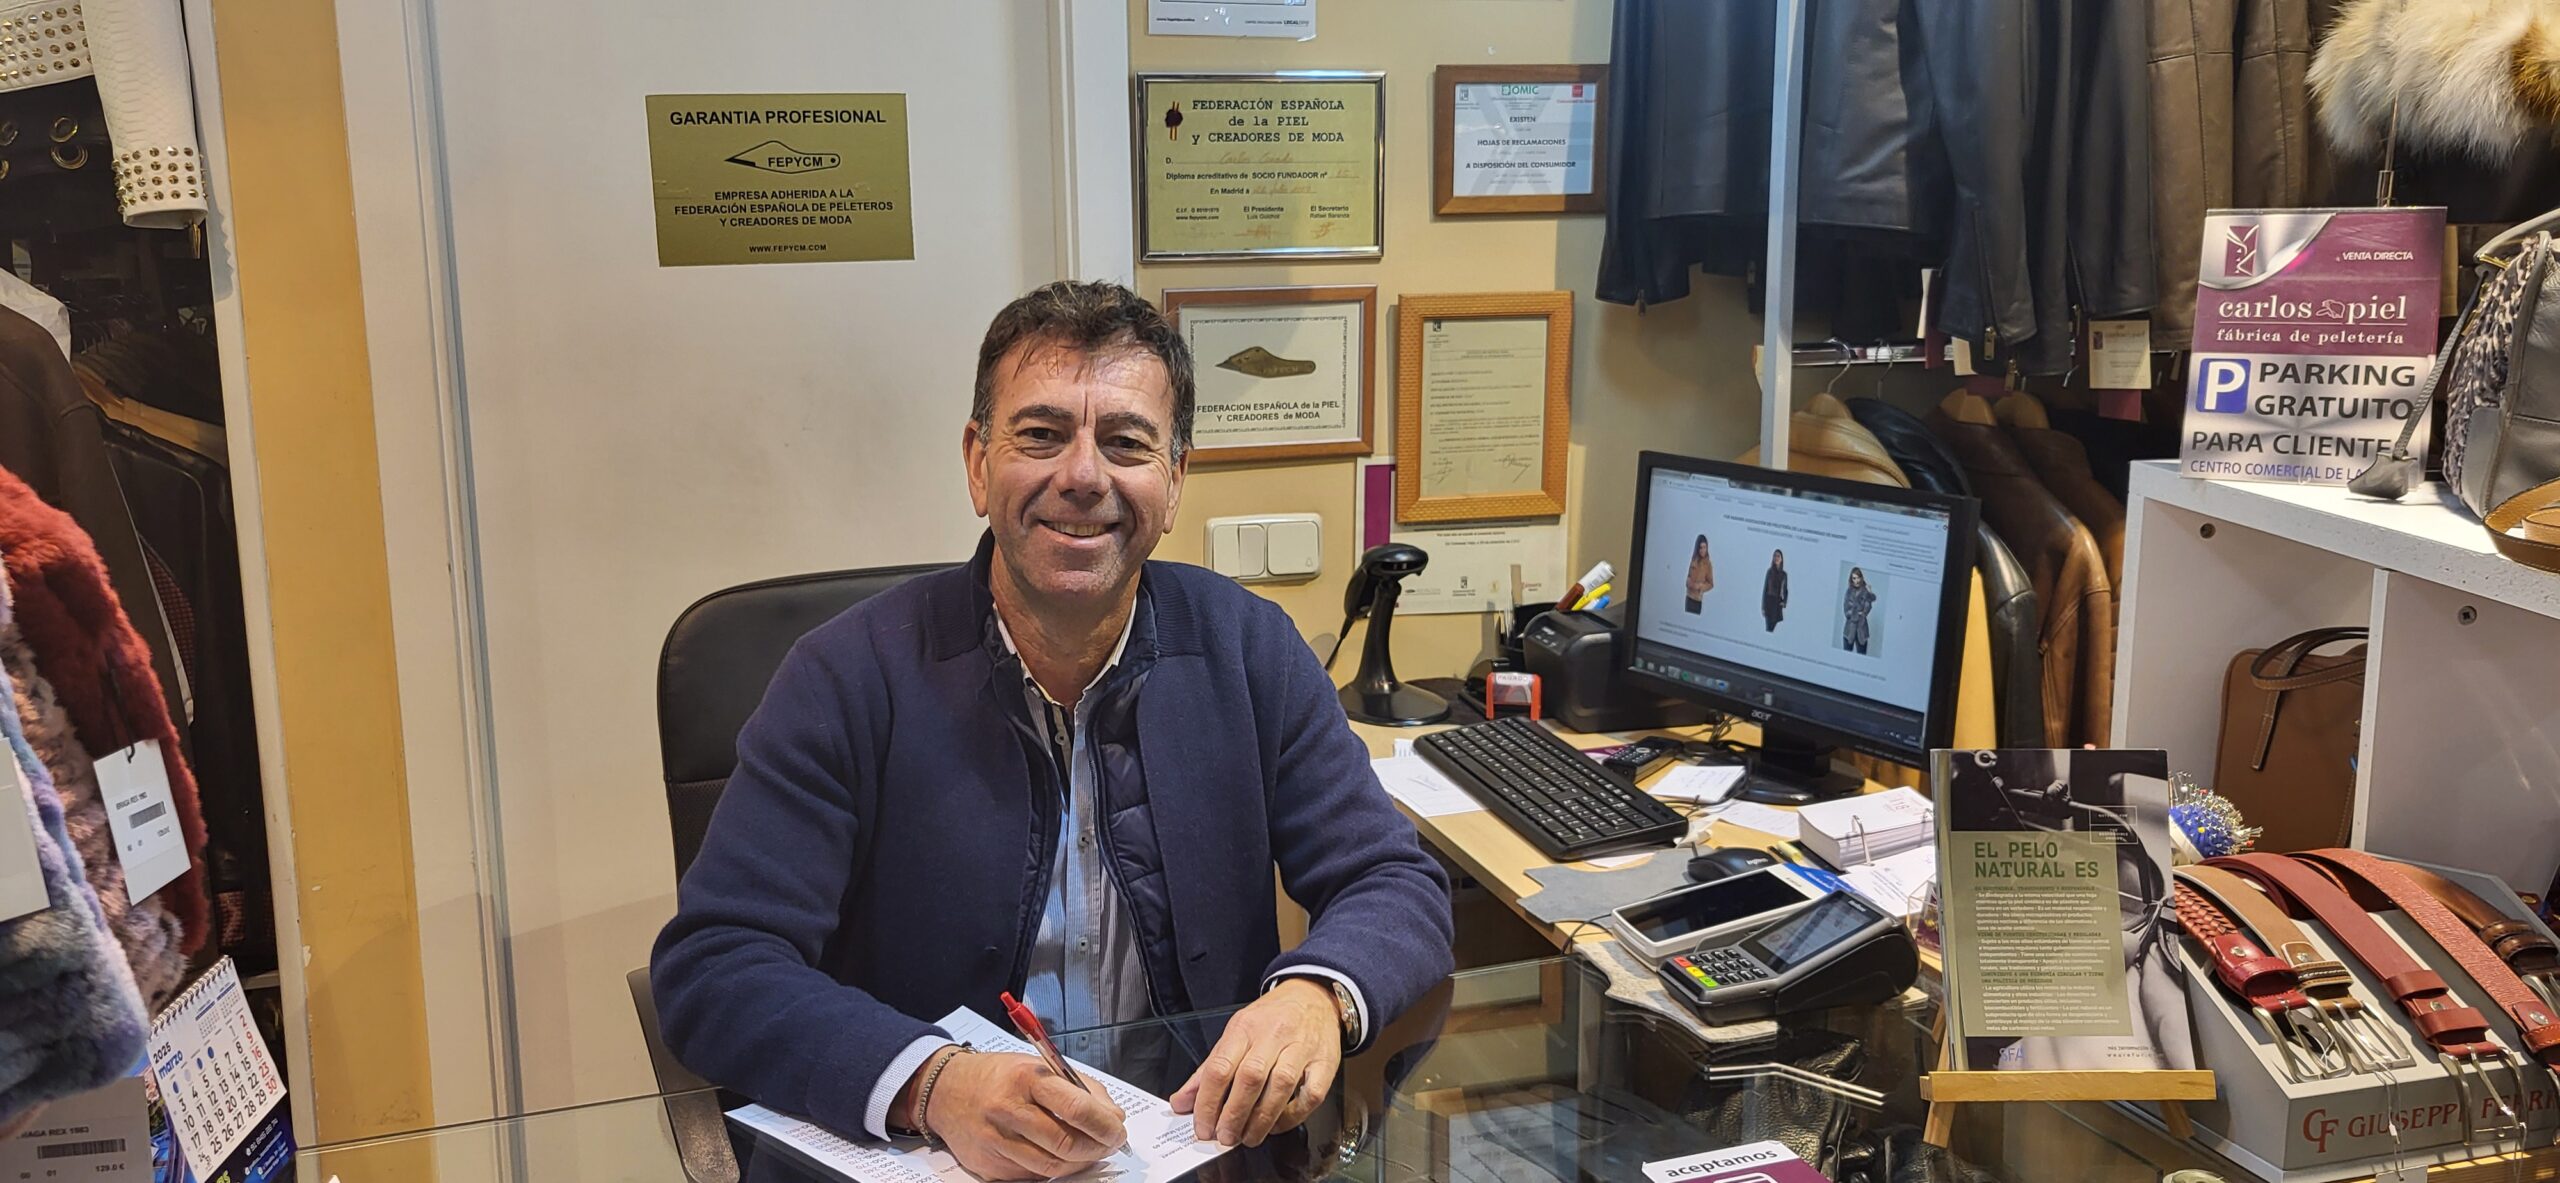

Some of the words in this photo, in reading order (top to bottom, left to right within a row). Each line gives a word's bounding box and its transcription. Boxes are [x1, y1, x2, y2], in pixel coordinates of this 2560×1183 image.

[1512, 86, 1538, 95] OMIC
[1192, 98, 1273, 110] FEDERACIÓN
[1281, 98, 1344, 110] ESPAÑOLA
[670, 111, 761, 125] GARANTIA
[766, 110, 886, 124] PROFESIONAL
[1229, 117, 1245, 126] de
[1253, 117, 1269, 126] la
[1277, 117, 1309, 126] PIEL
[1192, 135, 1199, 145] y
[1208, 132, 1280, 143] CREADORES
[1288, 133, 1304, 142] DE
[1312, 132, 1344, 142] MODA
[768, 157, 823, 167] FEPYCM
[1166, 172, 1195, 180] Diploma
[1197, 172, 1237, 180] acreditativo
[715, 191, 768, 201] EMPRESA
[771, 190, 827, 200] ADHERIDA
[829, 190, 838, 198] A
[839, 189, 854, 198] LA
[675, 203, 746, 215] FEDERACIÓN
[750, 202, 809, 213] ESPAÑOLA
[812, 202, 826, 212] DE
[829, 201, 893, 212] PELETEROS
[720, 218, 727, 227] Y
[730, 217, 799, 226] CREADORES
[802, 216, 816, 225] DE
[820, 215, 852, 225] MODA
[749, 244, 826, 253] WWW.FEPYCM.COM
[2343, 252, 2371, 260] VENTA
[2374, 252, 2413, 260] DIRECTA
[2219, 295, 2312, 319] carlos
[2348, 296, 2407, 324] piel
[2216, 329, 2281, 343] fábrica
[2290, 329, 2310, 343] de
[2318, 330, 2403, 345] peletería
[2259, 362, 2416, 387] PARKING
[2204, 361, 2246, 410] P
[1196, 404, 1250, 412] FEDERACION
[1253, 401, 1298, 411] ESPAÑOLA
[2254, 395, 2416, 420] GRATUITO
[1227, 413, 1279, 421] CREADORES
[2192, 431, 2264, 453] PARA
[2273, 434, 2408, 458] CLIENTE
[2190, 460, 2241, 474] CENTRO
[2245, 463, 2321, 479] COMERCIAL
[2326, 468, 2342, 479] DE
[1752, 710, 1772, 720] acer
[1975, 842, 1998, 858] EL
[2009, 842, 2058, 858] PELO
[1975, 862, 2064, 878] NATURAL
[2075, 862, 2098, 878] ES
[240, 1014, 247, 1027] 2
[153, 1042, 171, 1063] 2025
[159, 1050, 183, 1079] marzo
[179, 1098, 186, 1112] 3
[192, 1086, 198, 1099] 4
[203, 1074, 209, 1088] 5
[214, 1063, 221, 1076] 6
[225, 1052, 231, 1065] 7
[236, 1041, 243, 1053] 8
[246, 1032, 253, 1043] 9
[184, 1115, 195, 1131] 10
[197, 1103, 206, 1118] 11
[208, 1091, 218, 1106] 12
[219, 1079, 229, 1095] 13
[230, 1068, 240, 1083] 14
[241, 1056, 251, 1071] 15
[252, 1046, 262, 1060] 16
[191, 1132, 201, 1149] 17
[203, 1120, 214, 1136] 18
[214, 1108, 225, 1124] 19
[225, 1095, 237, 1113] 20
[238, 1085, 248, 1099] 21
[248, 1073, 259, 1089] 22
[259, 1062, 269, 1078] 23
[210, 1136, 222, 1154] 25
[222, 1124, 234, 1141] 26
[234, 1112, 244, 1129] 27
[245, 1100, 256, 1117] 28
[255, 1089, 266, 1105] 29
[266, 1078, 277, 1094] 30
[1666, 1148, 1778, 1179] aceptamos
